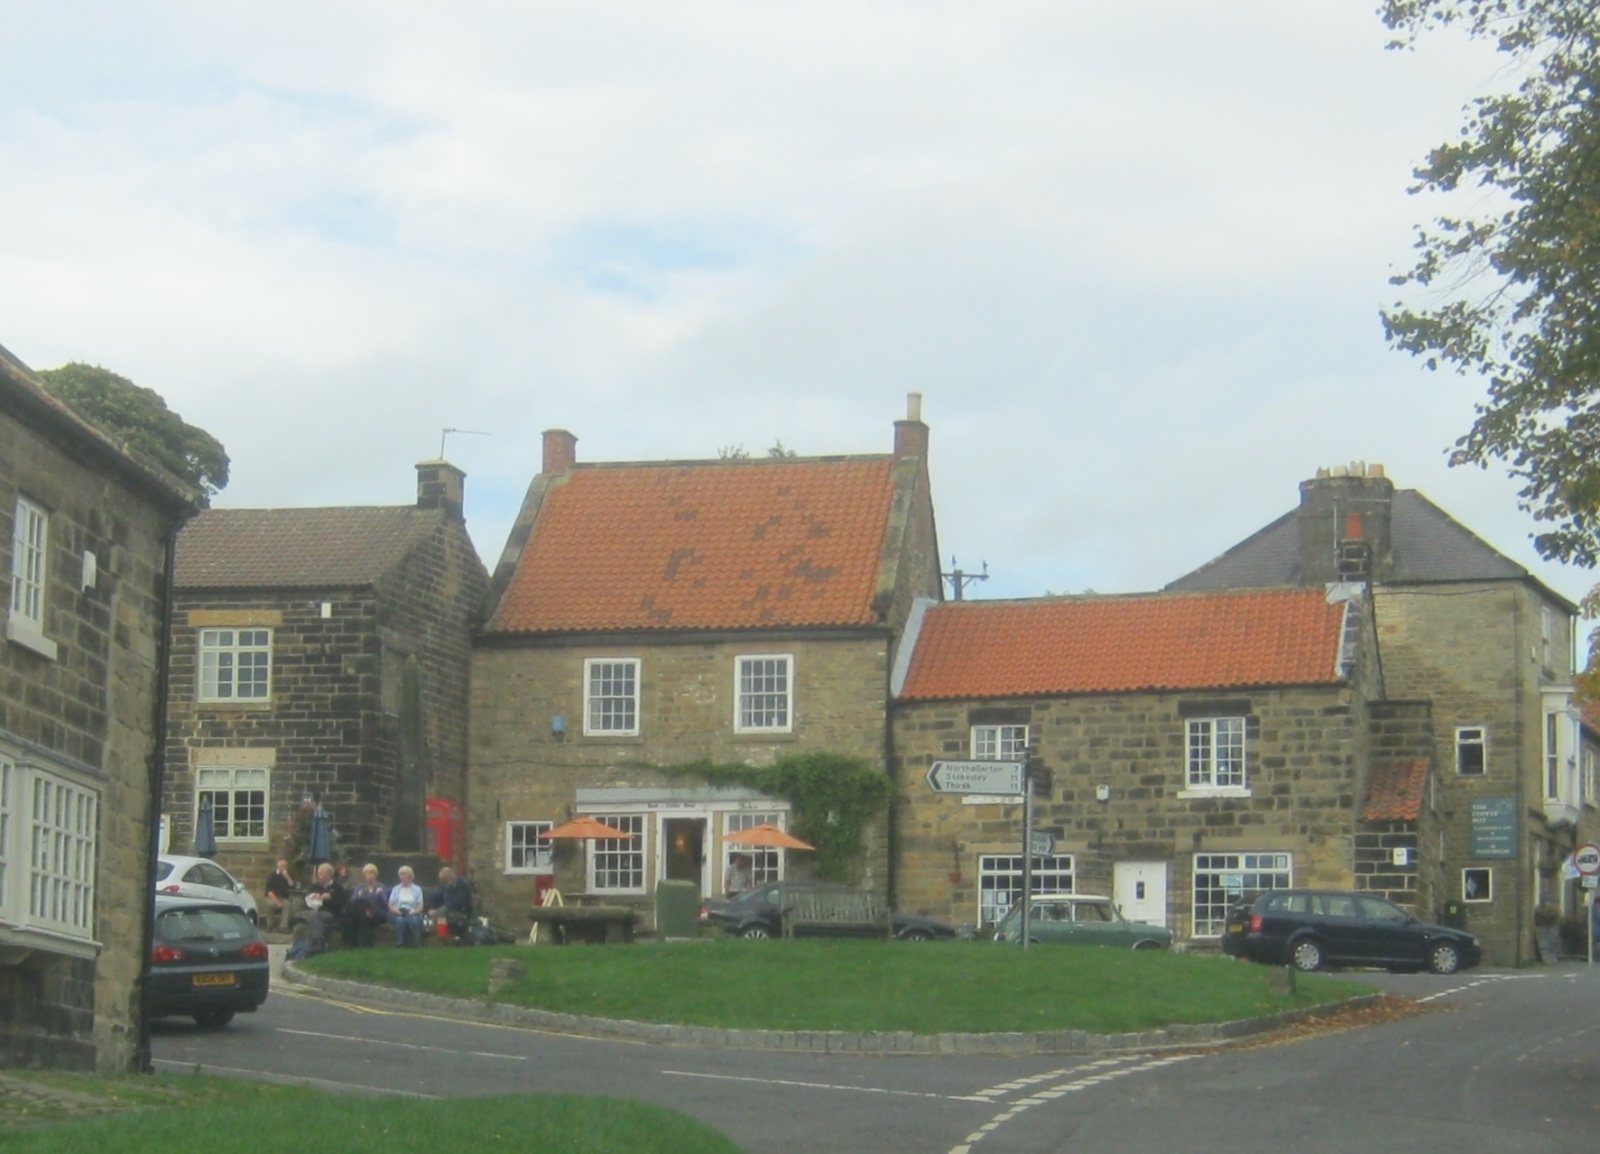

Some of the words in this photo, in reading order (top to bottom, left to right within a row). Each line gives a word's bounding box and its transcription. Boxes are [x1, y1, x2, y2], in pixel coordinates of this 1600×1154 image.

[946, 764, 1003, 772] Northallerton
[946, 773, 987, 782] Stokesley
[946, 781, 971, 789] Thirsk
